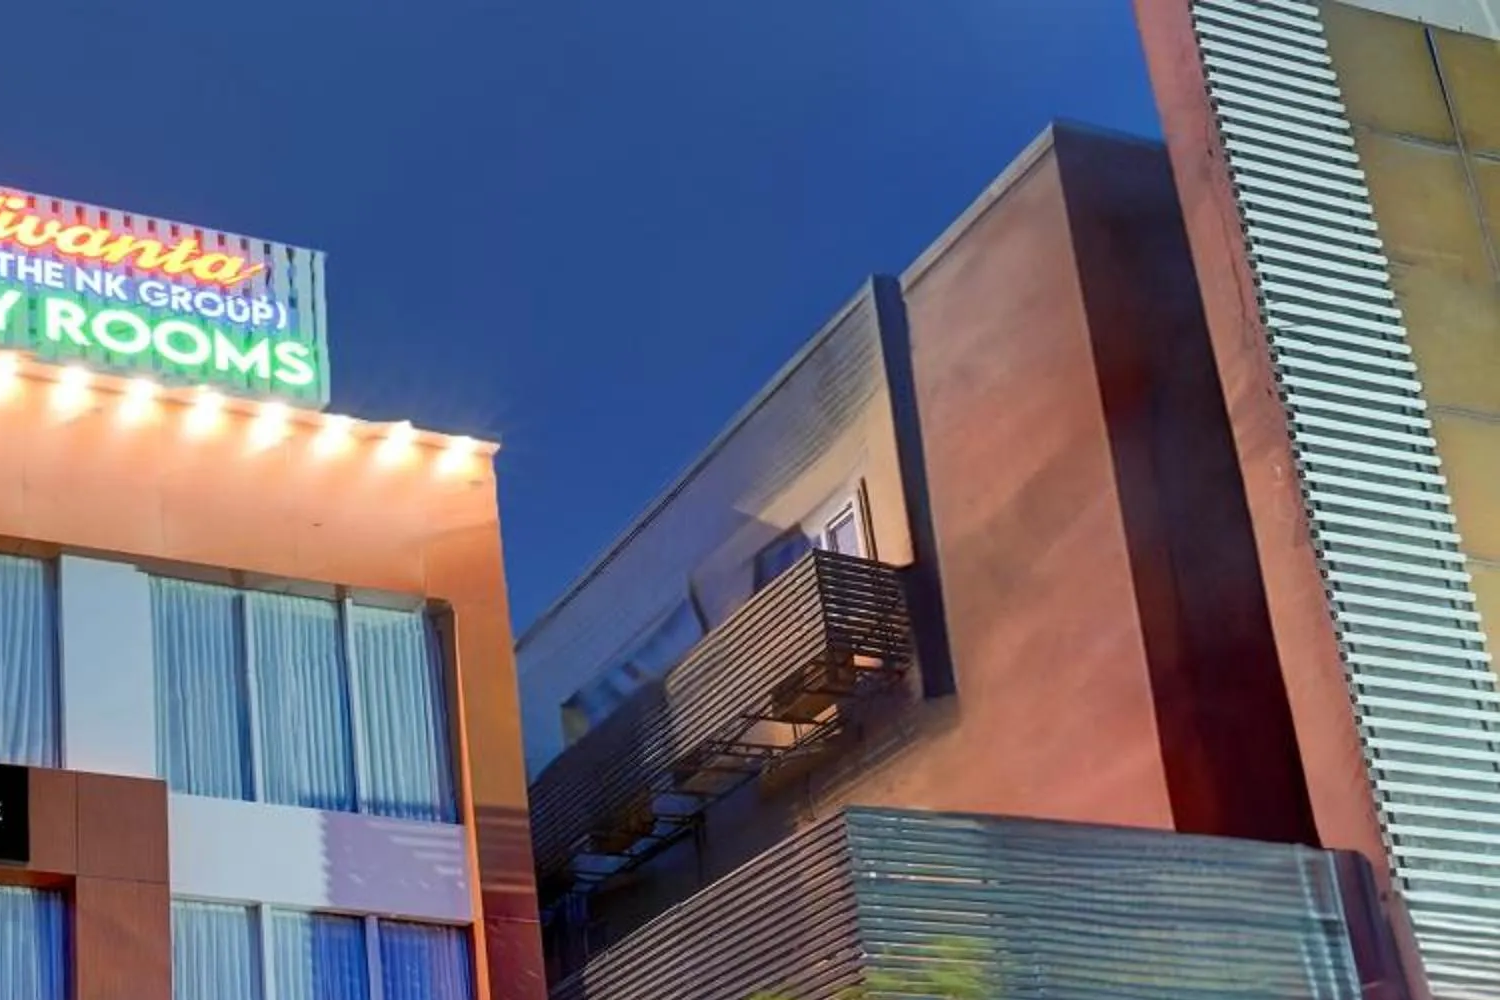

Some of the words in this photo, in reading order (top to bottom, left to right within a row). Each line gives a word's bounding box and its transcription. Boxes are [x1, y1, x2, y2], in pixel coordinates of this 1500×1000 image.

[75, 271, 129, 301] NK
[139, 281, 288, 329] GROUP)
[45, 297, 314, 385] ROOMS
